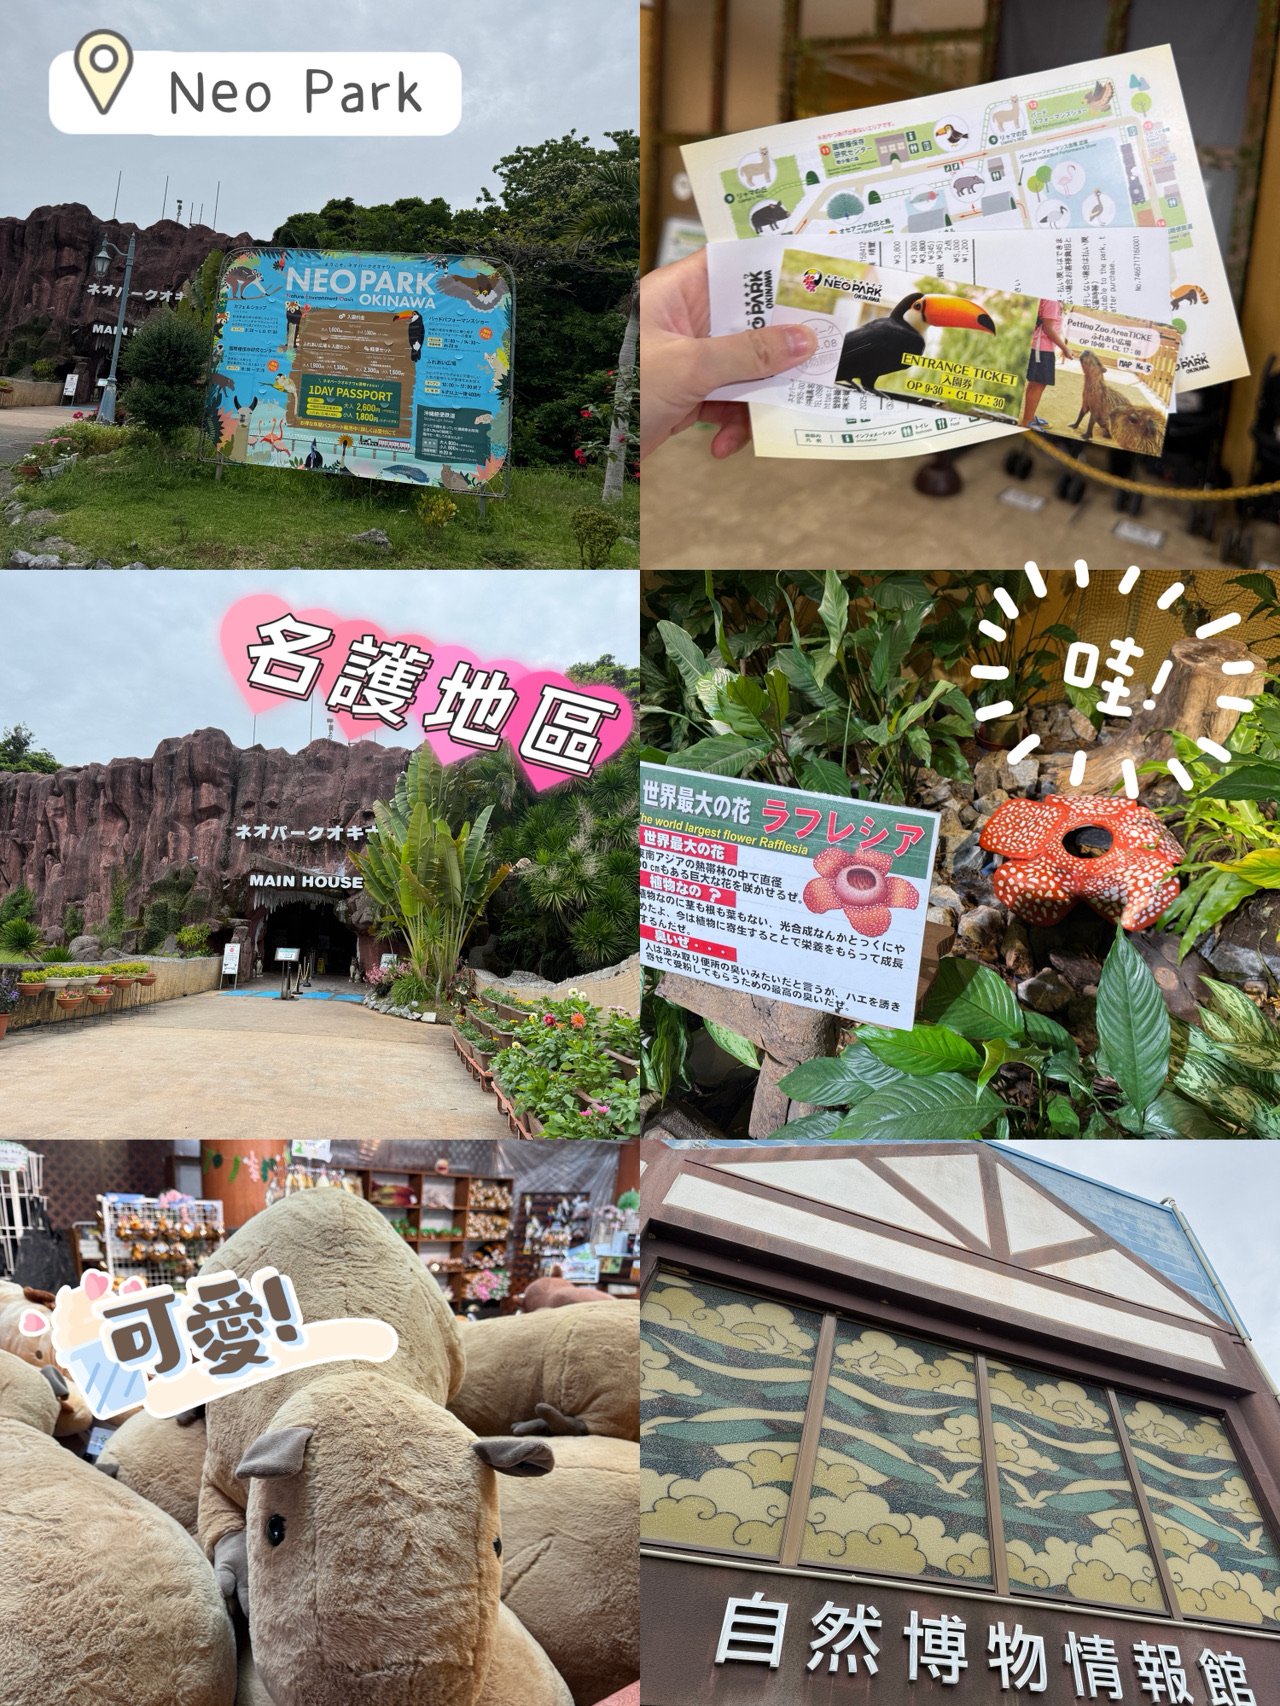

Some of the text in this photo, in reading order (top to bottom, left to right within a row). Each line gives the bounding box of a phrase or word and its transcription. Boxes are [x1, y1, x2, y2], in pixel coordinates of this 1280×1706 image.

[1030, 110, 1046, 118] バード
[1032, 108, 1088, 125] パフォーマンスショー
[1000, 130, 1028, 140] リャマの丘
[834, 146, 872, 158] 研究センター
[894, 240, 902, 264] ¥3,800
[764, 270, 774, 310] OKINAWA
[854, 293, 881, 303] OKINAWA
[360, 293, 436, 309] OKINAWA
[429, 316, 489, 325] バードパフォーマンスショー
[1067, 318, 1094, 331] Petting
[1095, 324, 1110, 334] Zoo
[93, 324, 128, 336] MAIN
[1091, 333, 1132, 347] ふれあい広場
[903, 354, 1017, 385] ENTRANCE TICKET
[1118, 360, 1132, 368] MAP
[1186, 364, 1210, 374] OKINAWA
[906, 380, 922, 390] OP
[956, 390, 970, 402] CL
[942, 376, 972, 390] 入園券
[308, 385, 393, 402] 1DAY PASSPORT
[854, 430, 897, 440] インフォメーション
[643, 779, 926, 858] 世界最大の花 ラフレシア
[644, 829, 726, 860] 世界最大の花
[655, 817, 683, 831] world
[685, 822, 721, 838] largest
[723, 829, 757, 846] flower
[758, 836, 808, 856] Rafflesia
[640, 848, 782, 888] 東南アジアの熱帯林の中で直径
[250, 874, 364, 889] MAIN HOUSE
[650, 874, 702, 898] 植物なの
[714, 1591, 1258, 1706] 自然博物情報館
